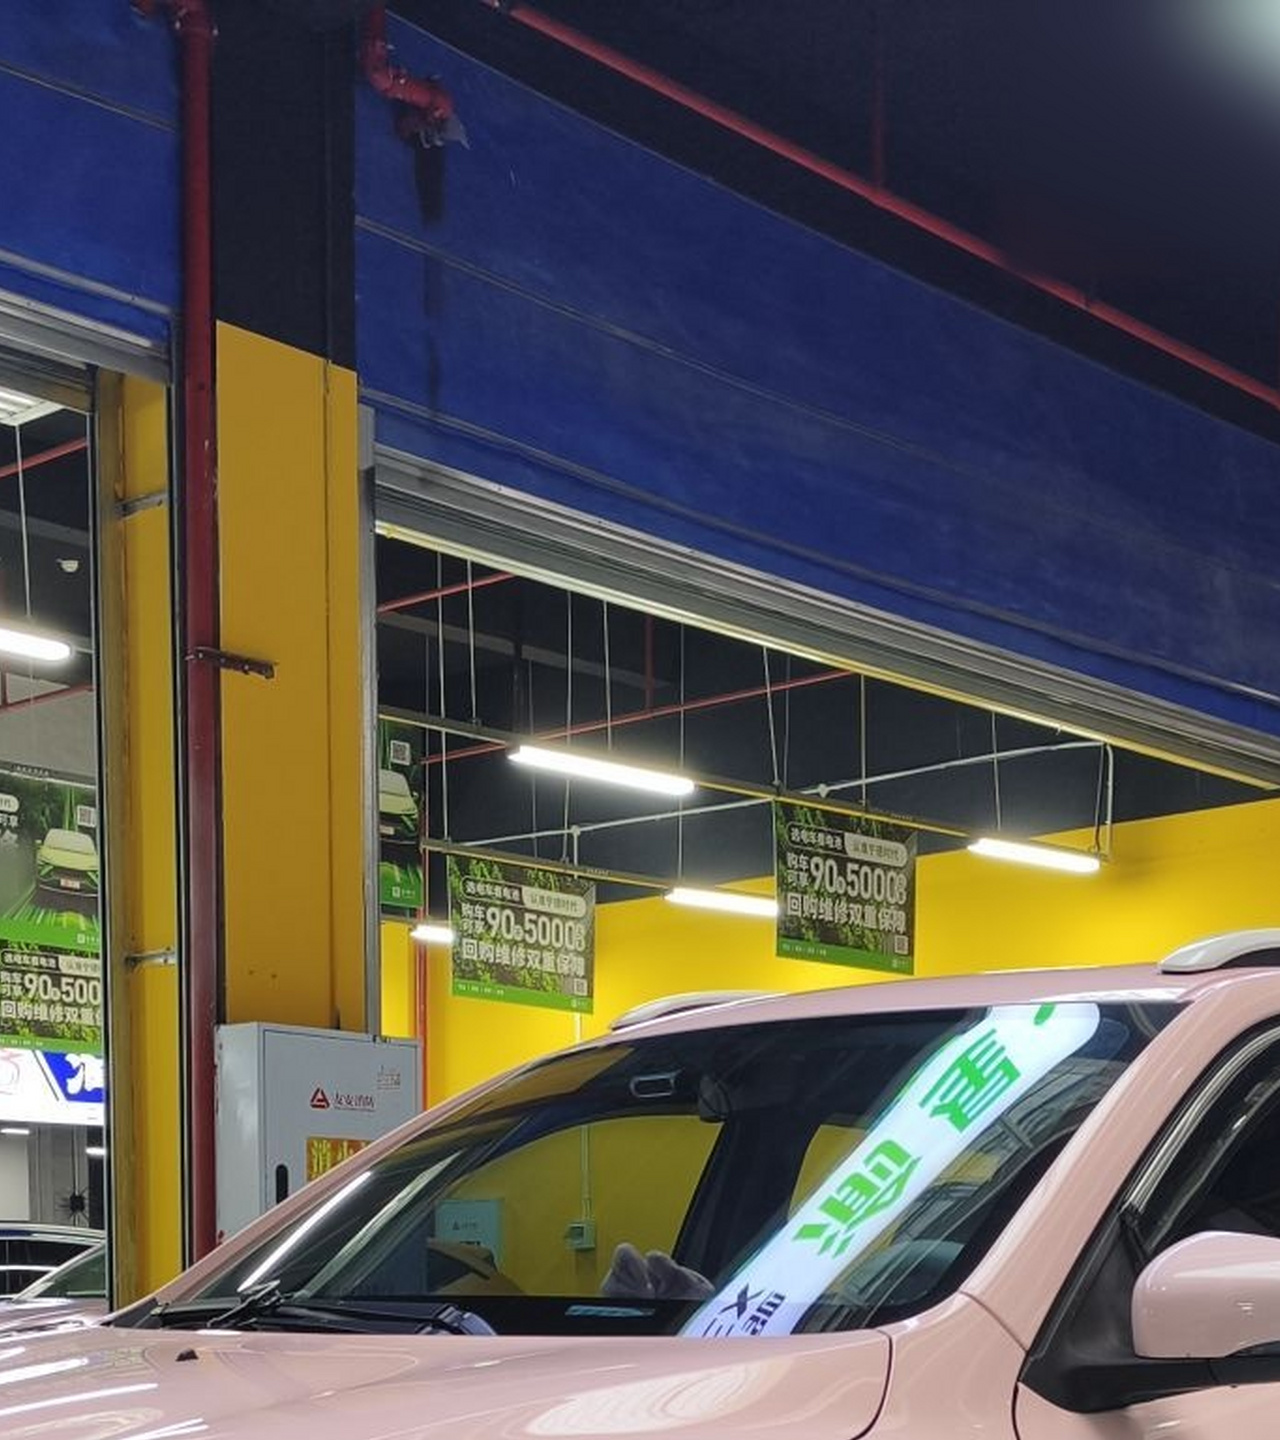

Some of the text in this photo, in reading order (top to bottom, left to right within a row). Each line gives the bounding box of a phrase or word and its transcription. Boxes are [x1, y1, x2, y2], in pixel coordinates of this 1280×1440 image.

[810, 856, 838, 894] 90
[486, 906, 515, 939] 90
[787, 893, 907, 934] 回购维修双重保障
[462, 937, 586, 977] 回购维修双重保障
[24, 972, 52, 1000] 90
